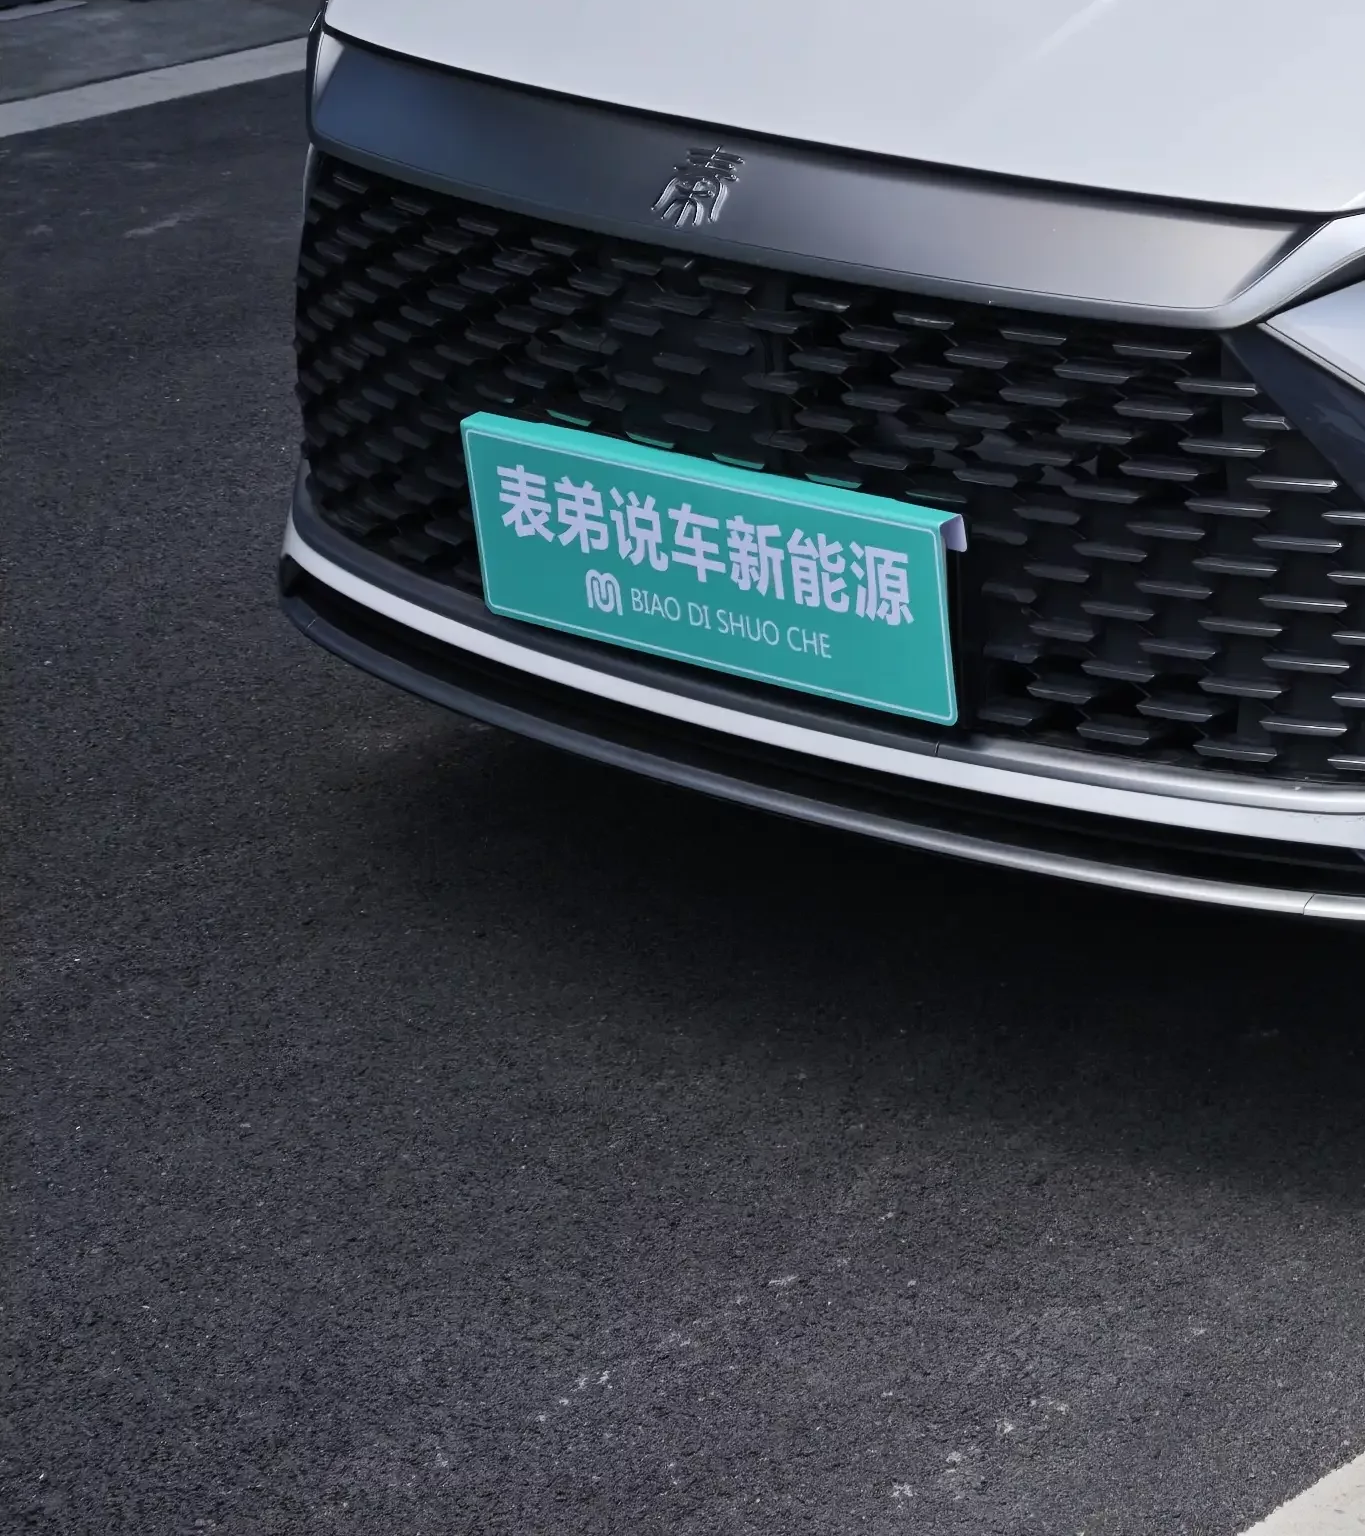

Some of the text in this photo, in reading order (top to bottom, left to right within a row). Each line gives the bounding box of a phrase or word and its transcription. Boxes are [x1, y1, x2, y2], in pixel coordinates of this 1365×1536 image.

[496, 464, 915, 626] 表弟说车新能源
[631, 587, 833, 659] BIAO DI SHUO CHE
